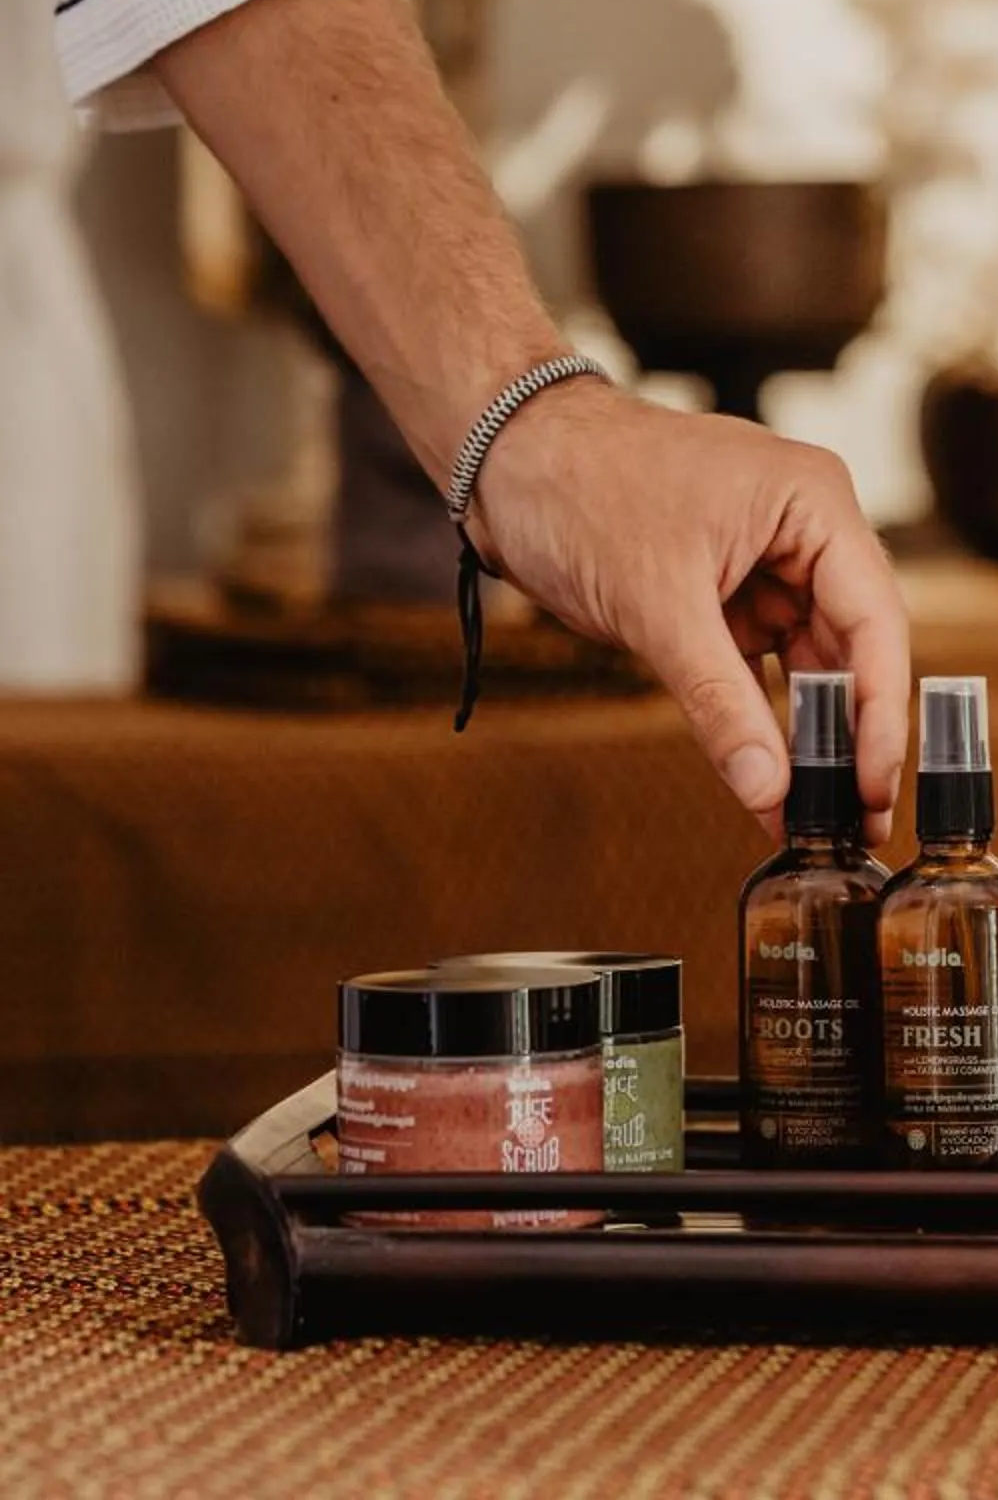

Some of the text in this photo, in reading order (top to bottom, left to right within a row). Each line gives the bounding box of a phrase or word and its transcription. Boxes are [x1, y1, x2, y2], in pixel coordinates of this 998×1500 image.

[797, 998, 843, 1009] MASSAGE
[941, 1005, 990, 1017] MASSAGE
[759, 1018, 843, 1040] ROOTS
[903, 1025, 982, 1047] FRESH
[505, 1093, 553, 1131] RICE
[502, 1136, 559, 1173] SCRUB
